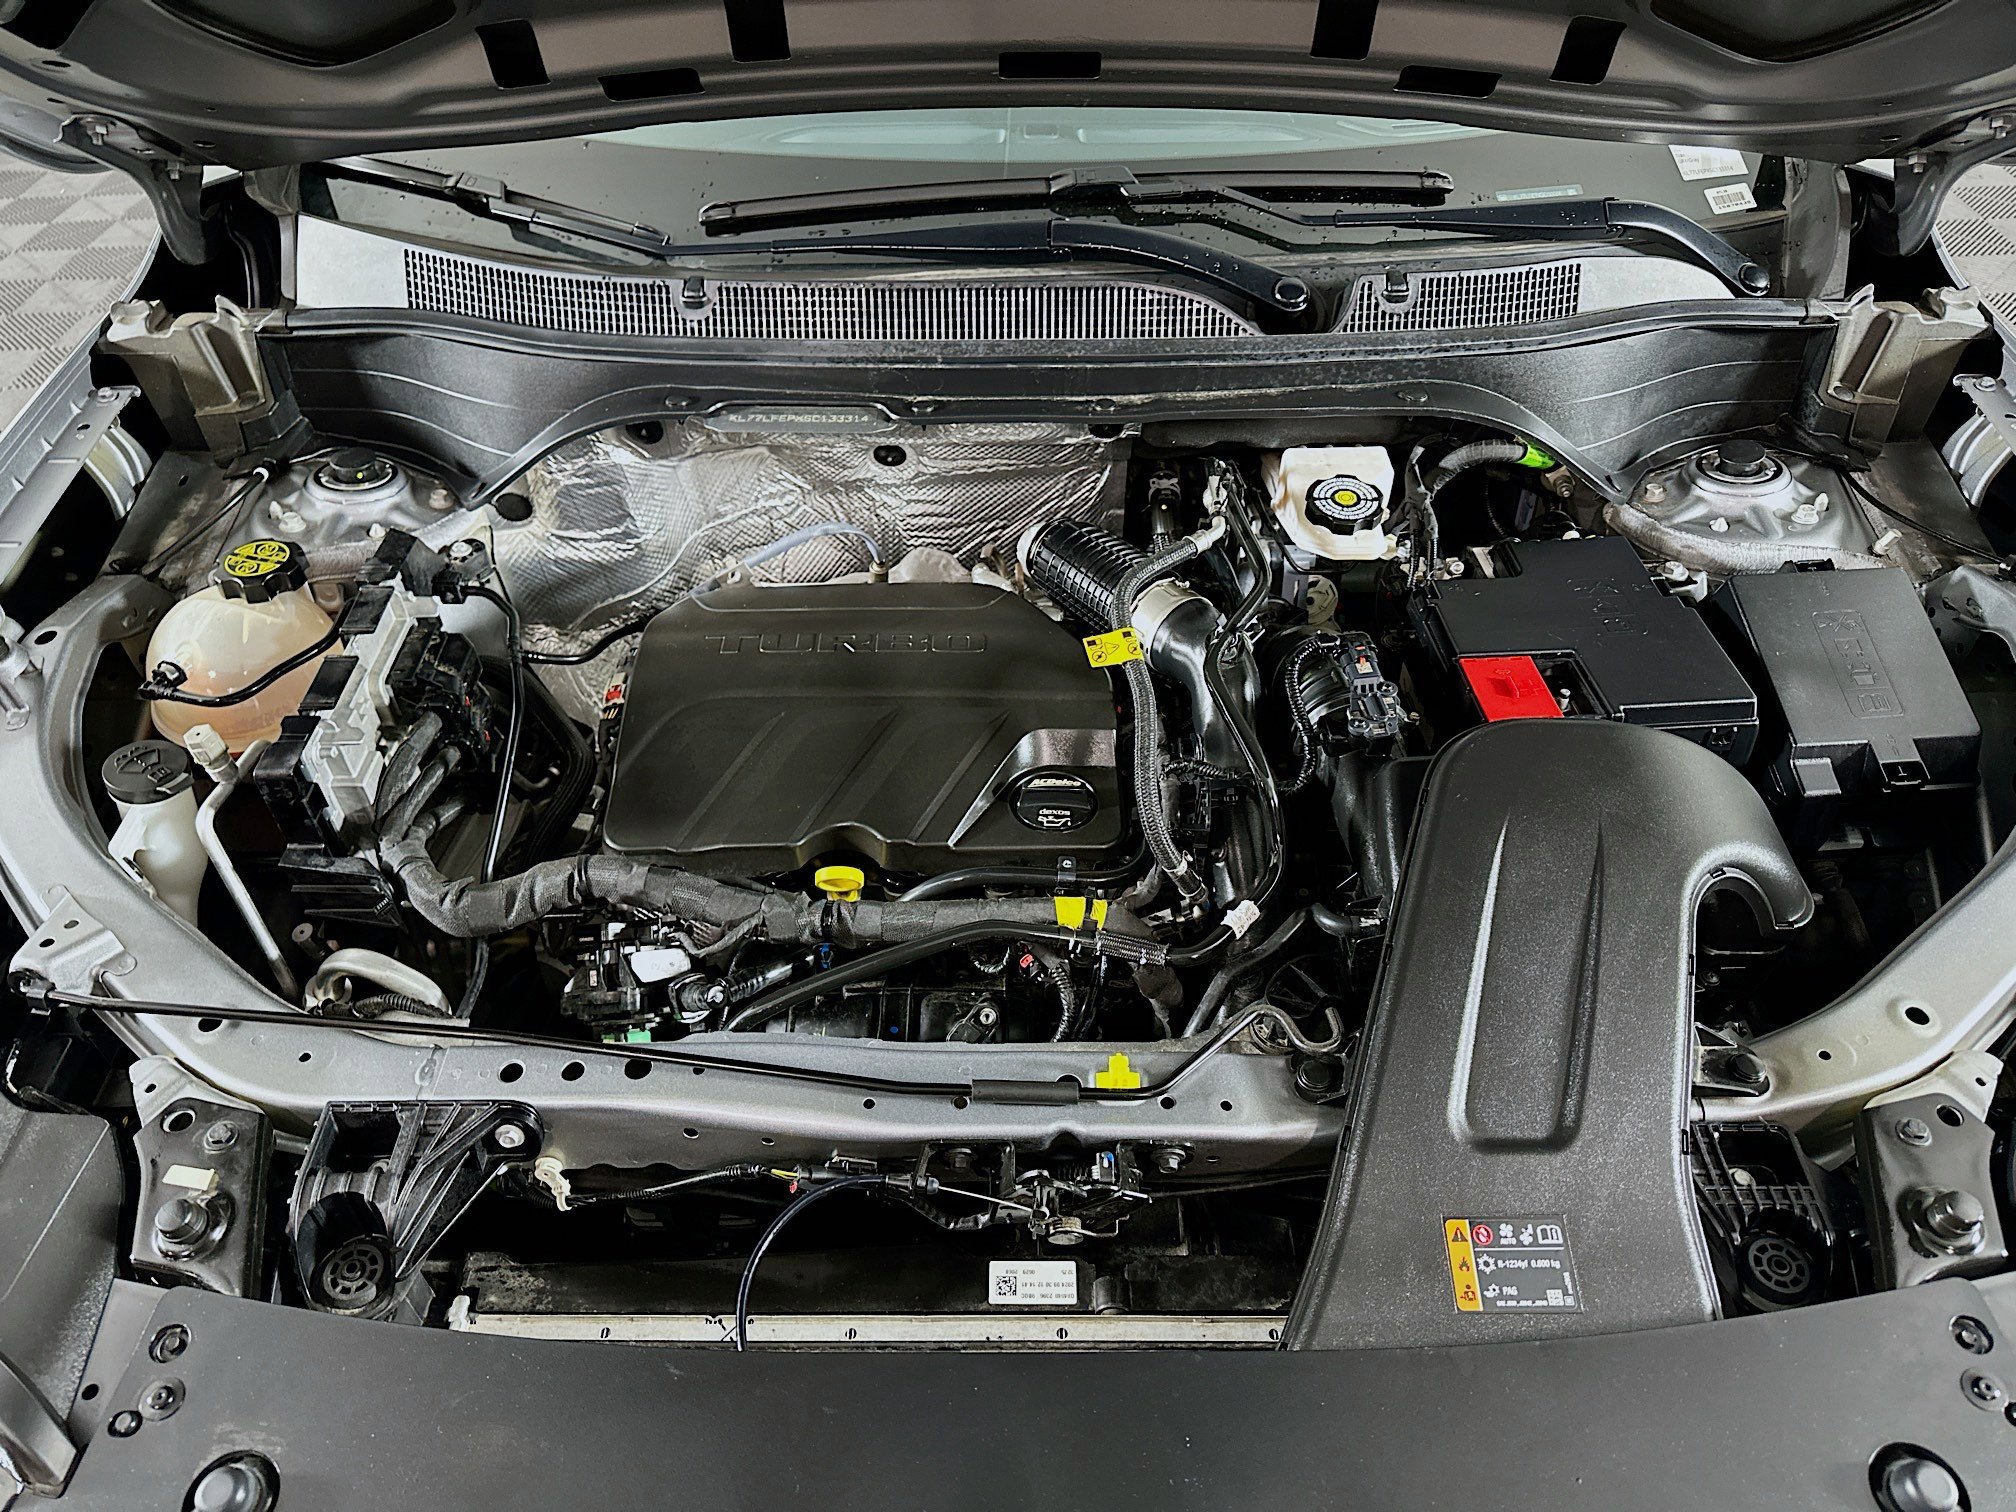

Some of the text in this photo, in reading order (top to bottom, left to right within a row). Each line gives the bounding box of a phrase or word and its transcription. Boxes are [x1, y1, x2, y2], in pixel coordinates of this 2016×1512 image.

[704, 632, 988, 653] TURBO
[1038, 808, 1071, 816] dexos
[1500, 1237, 1517, 1245] AUTO
[1497, 1259, 1528, 1269] R-1234yf
[1551, 1259, 1561, 1269] kg
[1502, 1286, 1518, 1296] PAG
